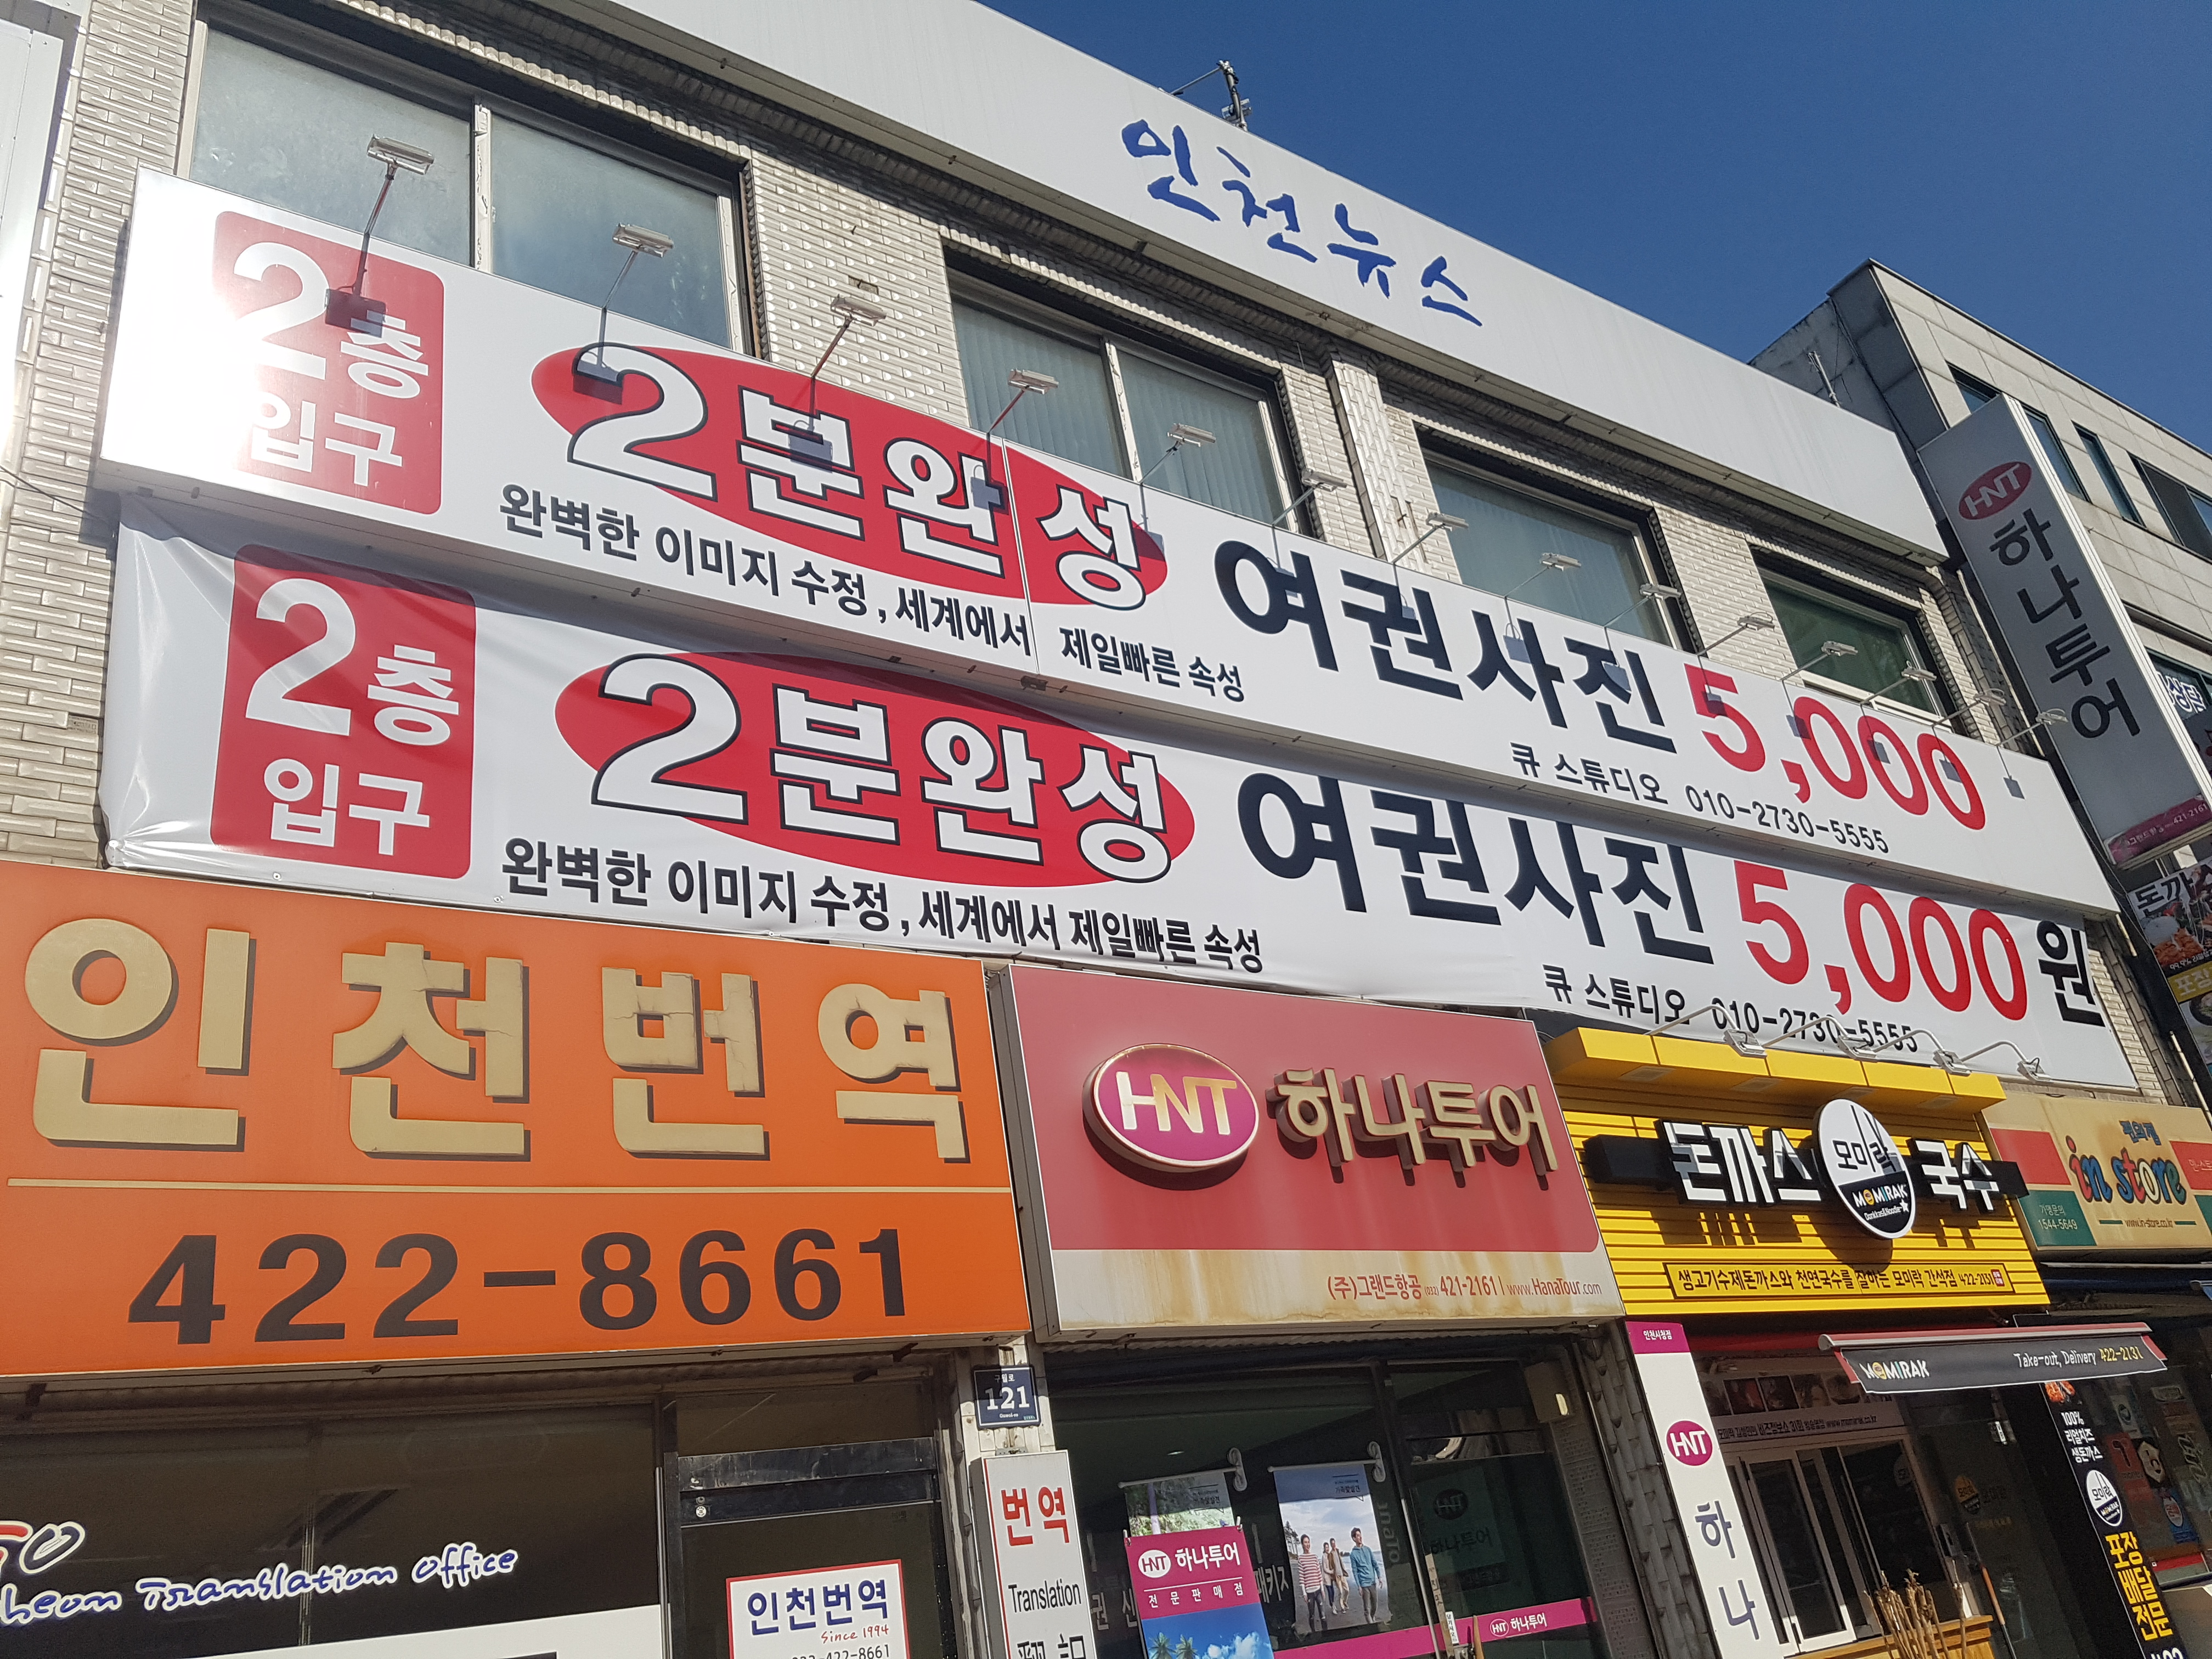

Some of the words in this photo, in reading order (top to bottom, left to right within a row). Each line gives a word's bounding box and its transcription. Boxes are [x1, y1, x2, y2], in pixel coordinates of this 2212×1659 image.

[1121, 119, 1482, 326] 인천뉴스
[227, 242, 428, 399] 2층
[250, 391, 402, 487] 입구
[567, 342, 1146, 610] 2분완성
[1964, 464, 2024, 516] HNT
[500, 484, 640, 561] 완벽한
[656, 527, 778, 596] 이미지
[895, 586, 1031, 657] 세계에서
[1059, 627, 1180, 689] 제일빠른
[1188, 657, 1245, 702] 속성
[1990, 508, 2140, 738] 하나투어
[246, 578, 459, 746] 2층
[1214, 540, 1677, 754] 여권사진
[1684, 663, 1986, 831] 5,000
[2157, 670, 2207, 713] 상담
[591, 653, 1172, 883] 2분완성
[264, 758, 430, 856] 입구
[1510, 742, 1539, 778] 큐
[1554, 754, 1668, 805] 스튜디오
[1685, 785, 1889, 854] 010-2730-5555
[1238, 772, 1714, 964] 여권사진
[503, 838, 651, 906] 완벽한
[668, 860, 797, 923] 이미지
[918, 890, 1060, 950] 세계에서
[1068, 909, 1197, 964] 제일빠른
[1204, 924, 1263, 973] 속성
[1542, 964, 1572, 1005] 큐
[1585, 973, 1690, 1025] 스튜디오
[1712, 997, 1918, 1053] 010-2730-5555
[25, 918, 967, 1160] 인천번역
[1116, 1071, 1237, 1135] HNT
[1274, 1068, 1558, 1171] 하나투어
[1663, 1122, 1821, 1204] 돈까스
[1915, 1139, 1999, 1211] 국수
[2111, 1148, 2186, 1205] store
[2038, 1220, 2078, 1230] 1544-5649
[128, 1228, 905, 1344] 422-8661
[1328, 1274, 1421, 1300] (주)그랜드항공
[1441, 1276, 1497, 1296] 421-2161
[1507, 1278, 1602, 1296] www.HanaTour.com
[1892, 1269, 1925, 1288] 모미락
[1924, 1269, 1958, 1288] 간석점
[1957, 1273, 1994, 1286] 422-2131
[1643, 1329, 1672, 1340] 인천시청점
[994, 1374, 1015, 1383] 구월로
[1860, 1360, 1929, 1379] MOMIRAK
[2064, 1350, 2096, 1365] Delivery
[2099, 1346, 2143, 1362] 422-2131
[985, 1385, 1030, 1410] 121
[2061, 1410, 2084, 1425] 100%
[1670, 1430, 1707, 1457] HNT
[2064, 1428, 2095, 1444] 리얼치즈
[2072, 1446, 2103, 1463] 생돈까스
[1001, 1486, 1069, 1546] 번역
[1143, 1554, 1170, 1573] HNT
[1175, 1542, 1240, 1572] 하나투어
[2106, 1531, 2143, 1568] 포장
[136, 1563, 397, 1611] Translation
[748, 1579, 888, 1636] 인천번역
[1008, 1578, 1081, 1613] Translation
[1091, 1592, 1109, 1630] 권
[2118, 1566, 2158, 1604] 배달
[821, 1631, 857, 1644] Since
[864, 1624, 889, 1637] 1994
[1510, 1612, 1547, 1631] 하나투어
[2132, 1601, 2173, 1641] 전문
